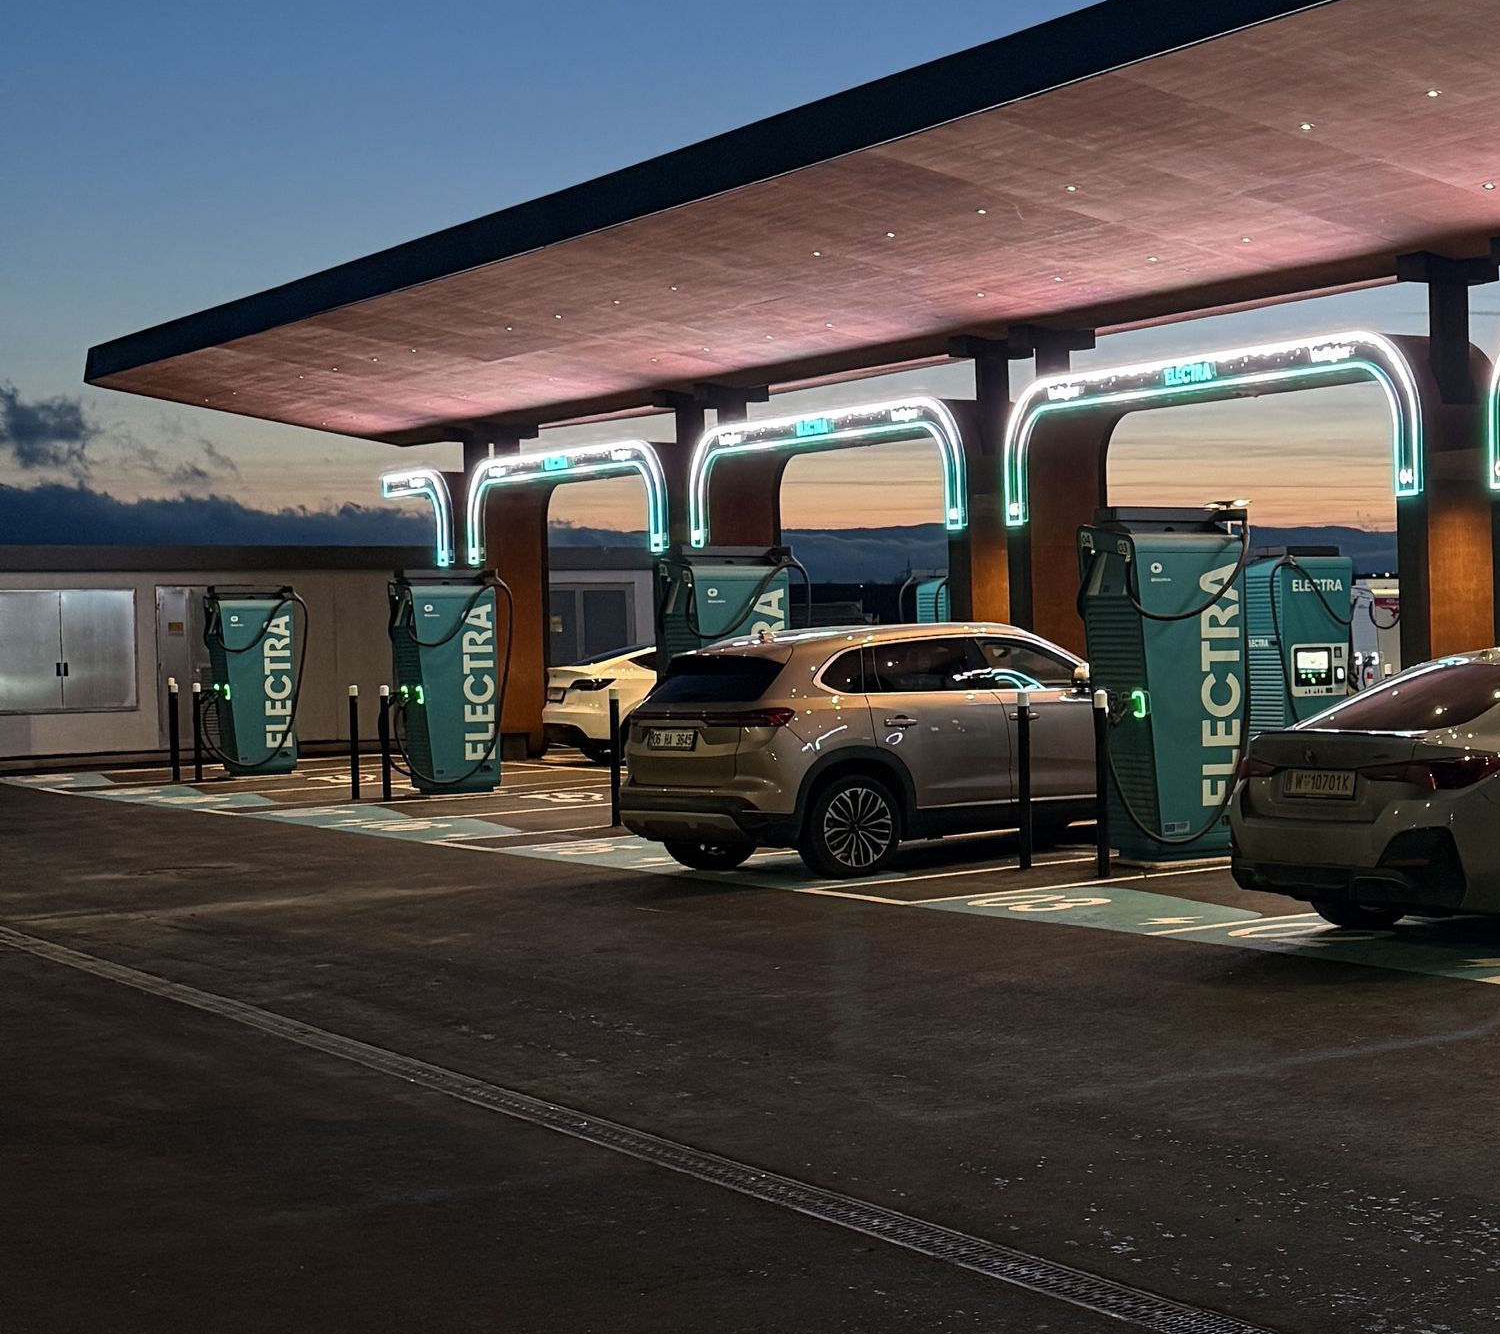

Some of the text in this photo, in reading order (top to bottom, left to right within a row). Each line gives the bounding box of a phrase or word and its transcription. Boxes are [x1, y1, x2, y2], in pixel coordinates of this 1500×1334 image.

[1164, 362, 1213, 386] ELECTRA
[263, 614, 293, 749] ELECTRA
[462, 602, 496, 761] ELECTRA
[1199, 562, 1241, 807] ELECTRA
[967, 894, 1112, 912] 03
